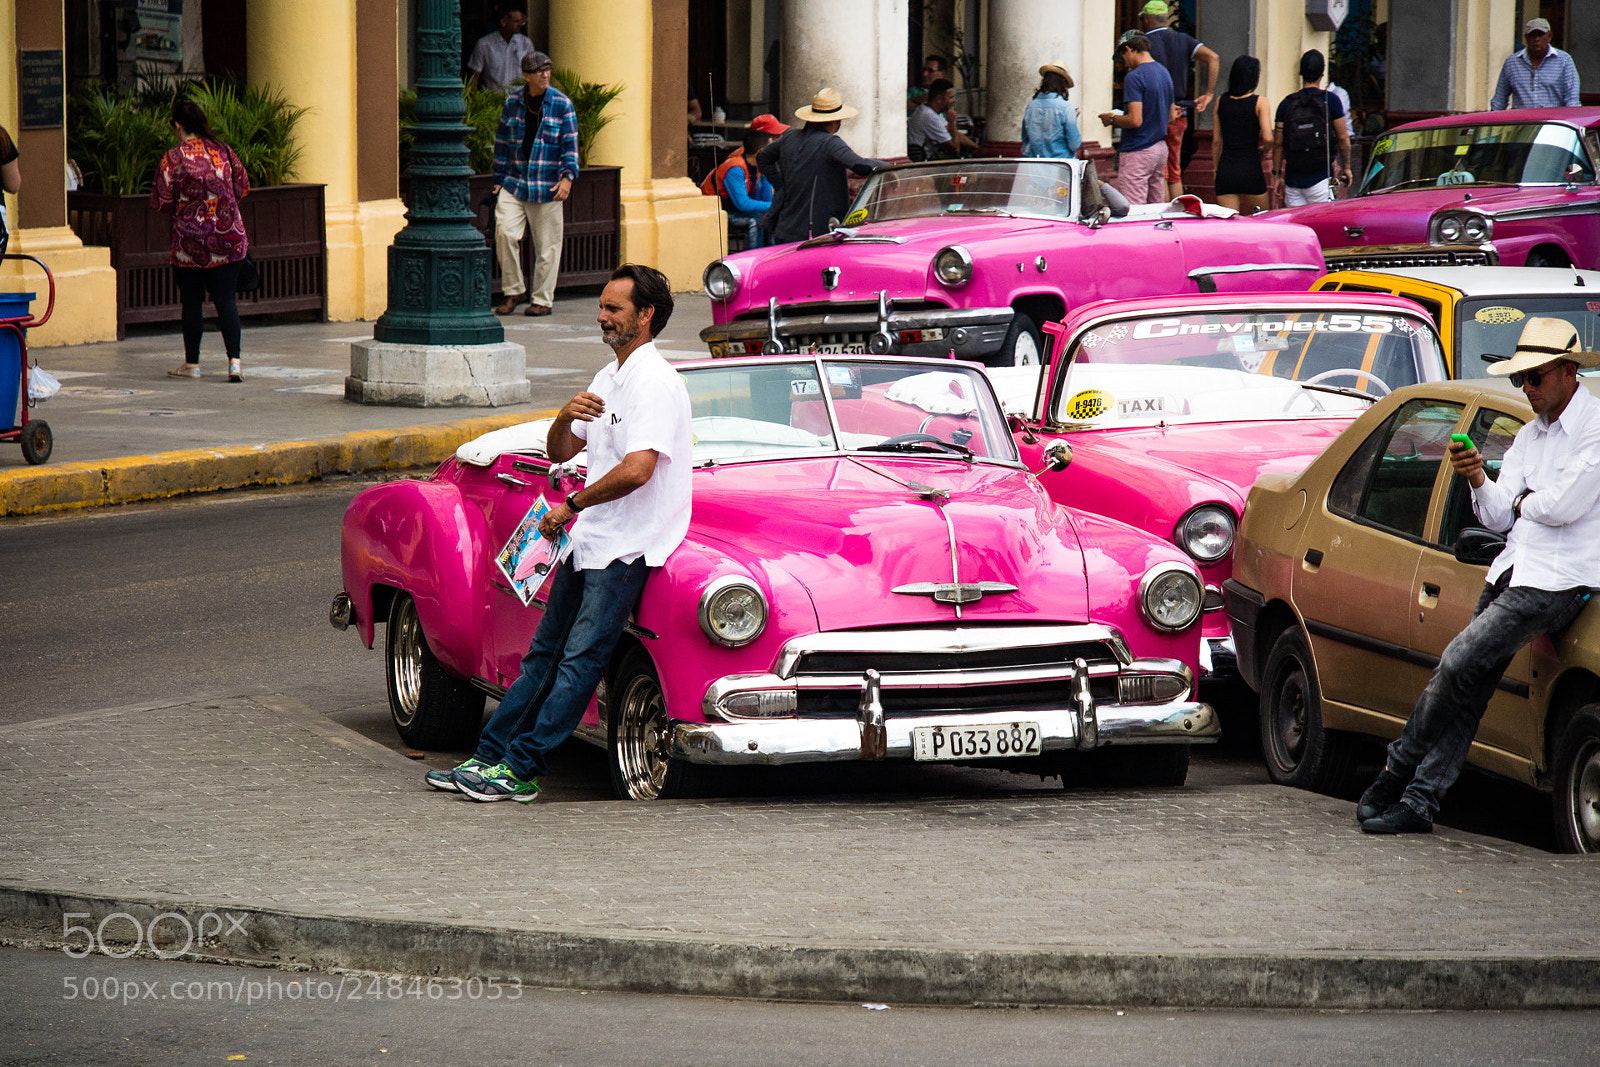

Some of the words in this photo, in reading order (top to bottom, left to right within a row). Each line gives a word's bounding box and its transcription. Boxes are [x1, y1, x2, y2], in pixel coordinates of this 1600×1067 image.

[1440, 175, 1465, 184] TAXI
[792, 381, 807, 393] 17
[1120, 396, 1163, 414] TAXI
